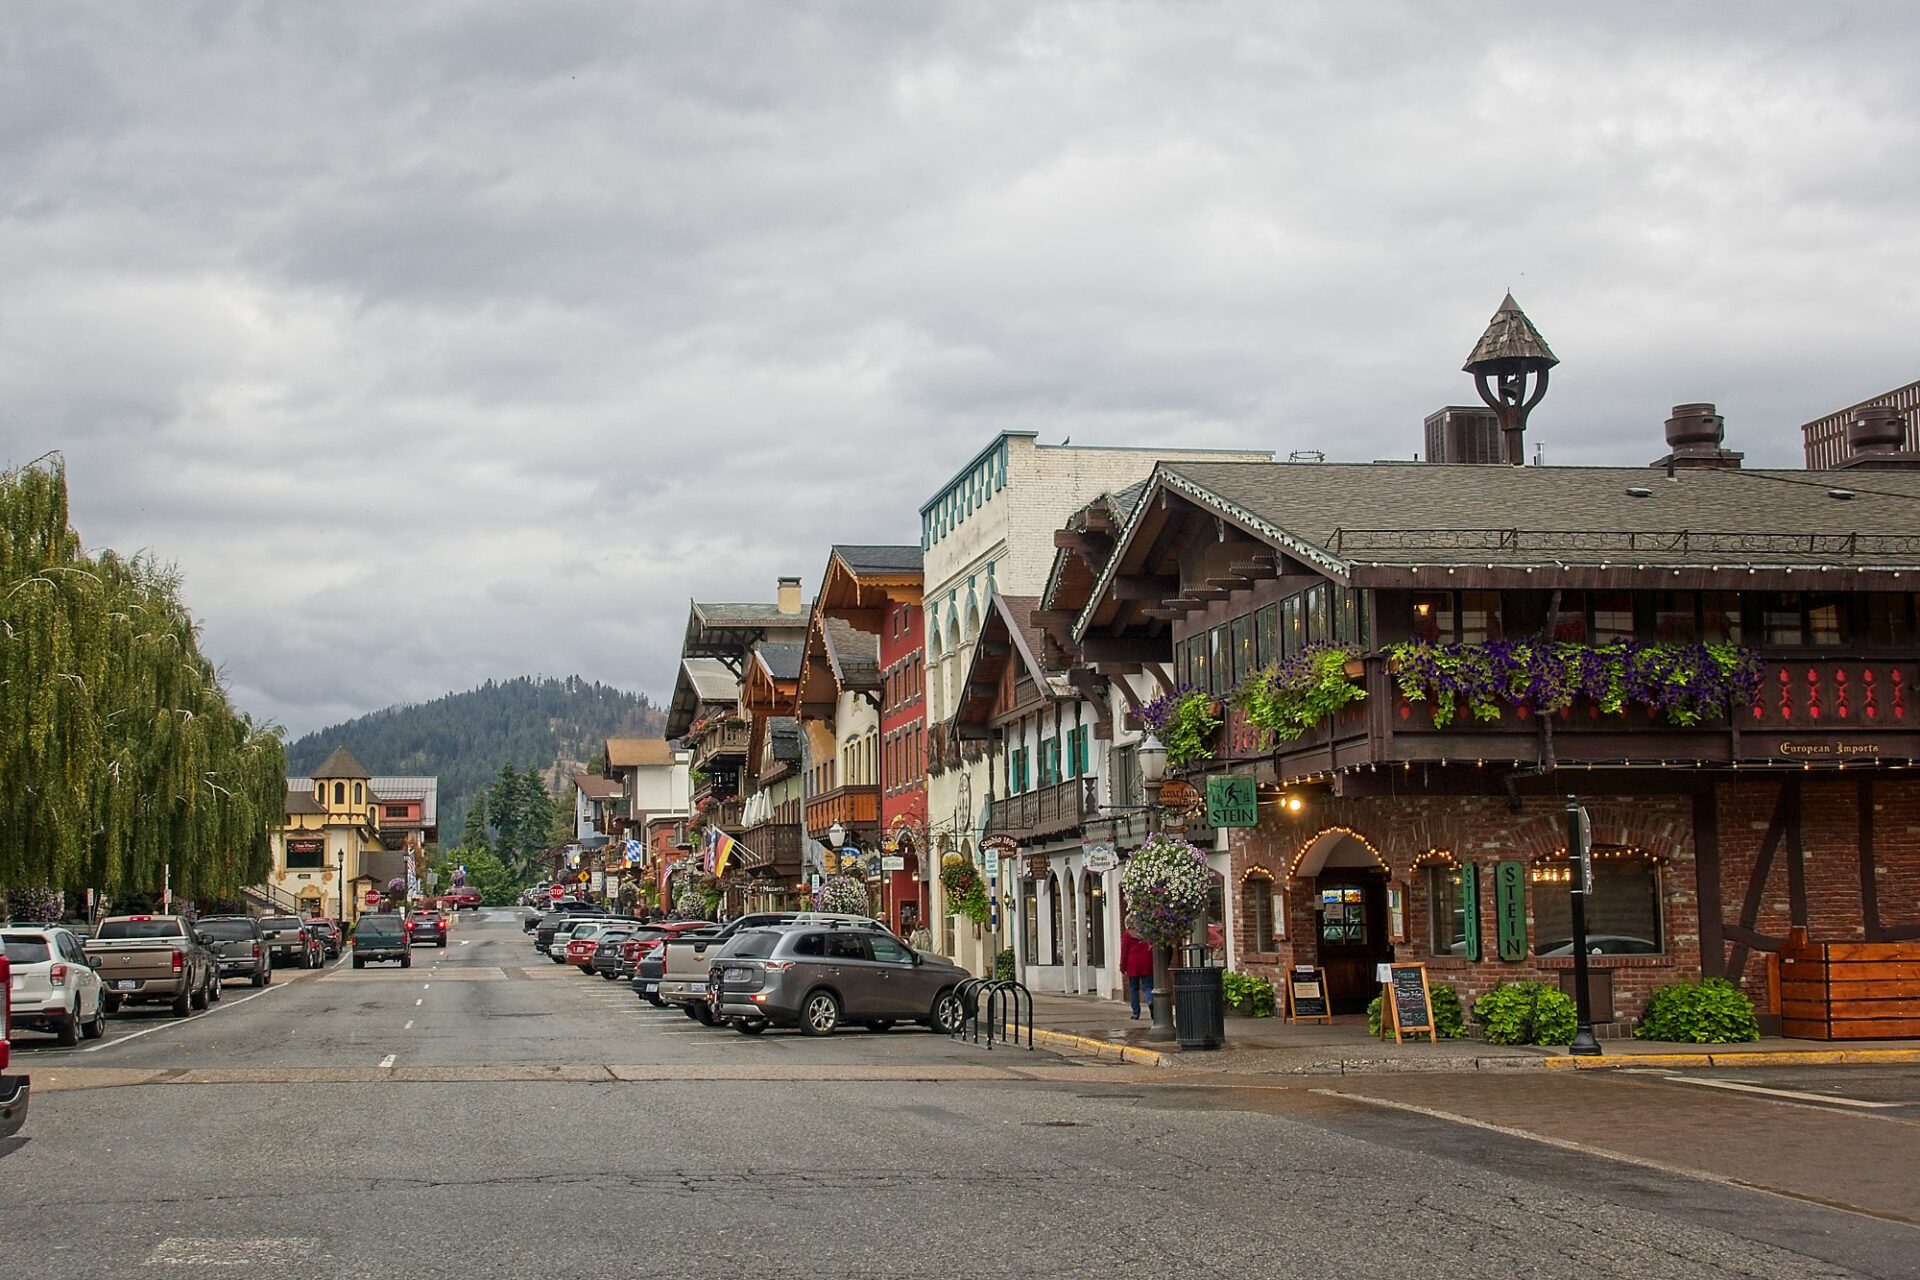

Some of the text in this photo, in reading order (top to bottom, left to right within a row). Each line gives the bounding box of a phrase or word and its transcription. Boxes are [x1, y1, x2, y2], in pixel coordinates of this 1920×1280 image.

[1780, 741, 1879, 755] European Imports
[1212, 808, 1254, 823] STEIN
[550, 888, 564, 896] STOP
[1466, 868, 1475, 956] STEIN
[1505, 866, 1520, 955] STEIN
